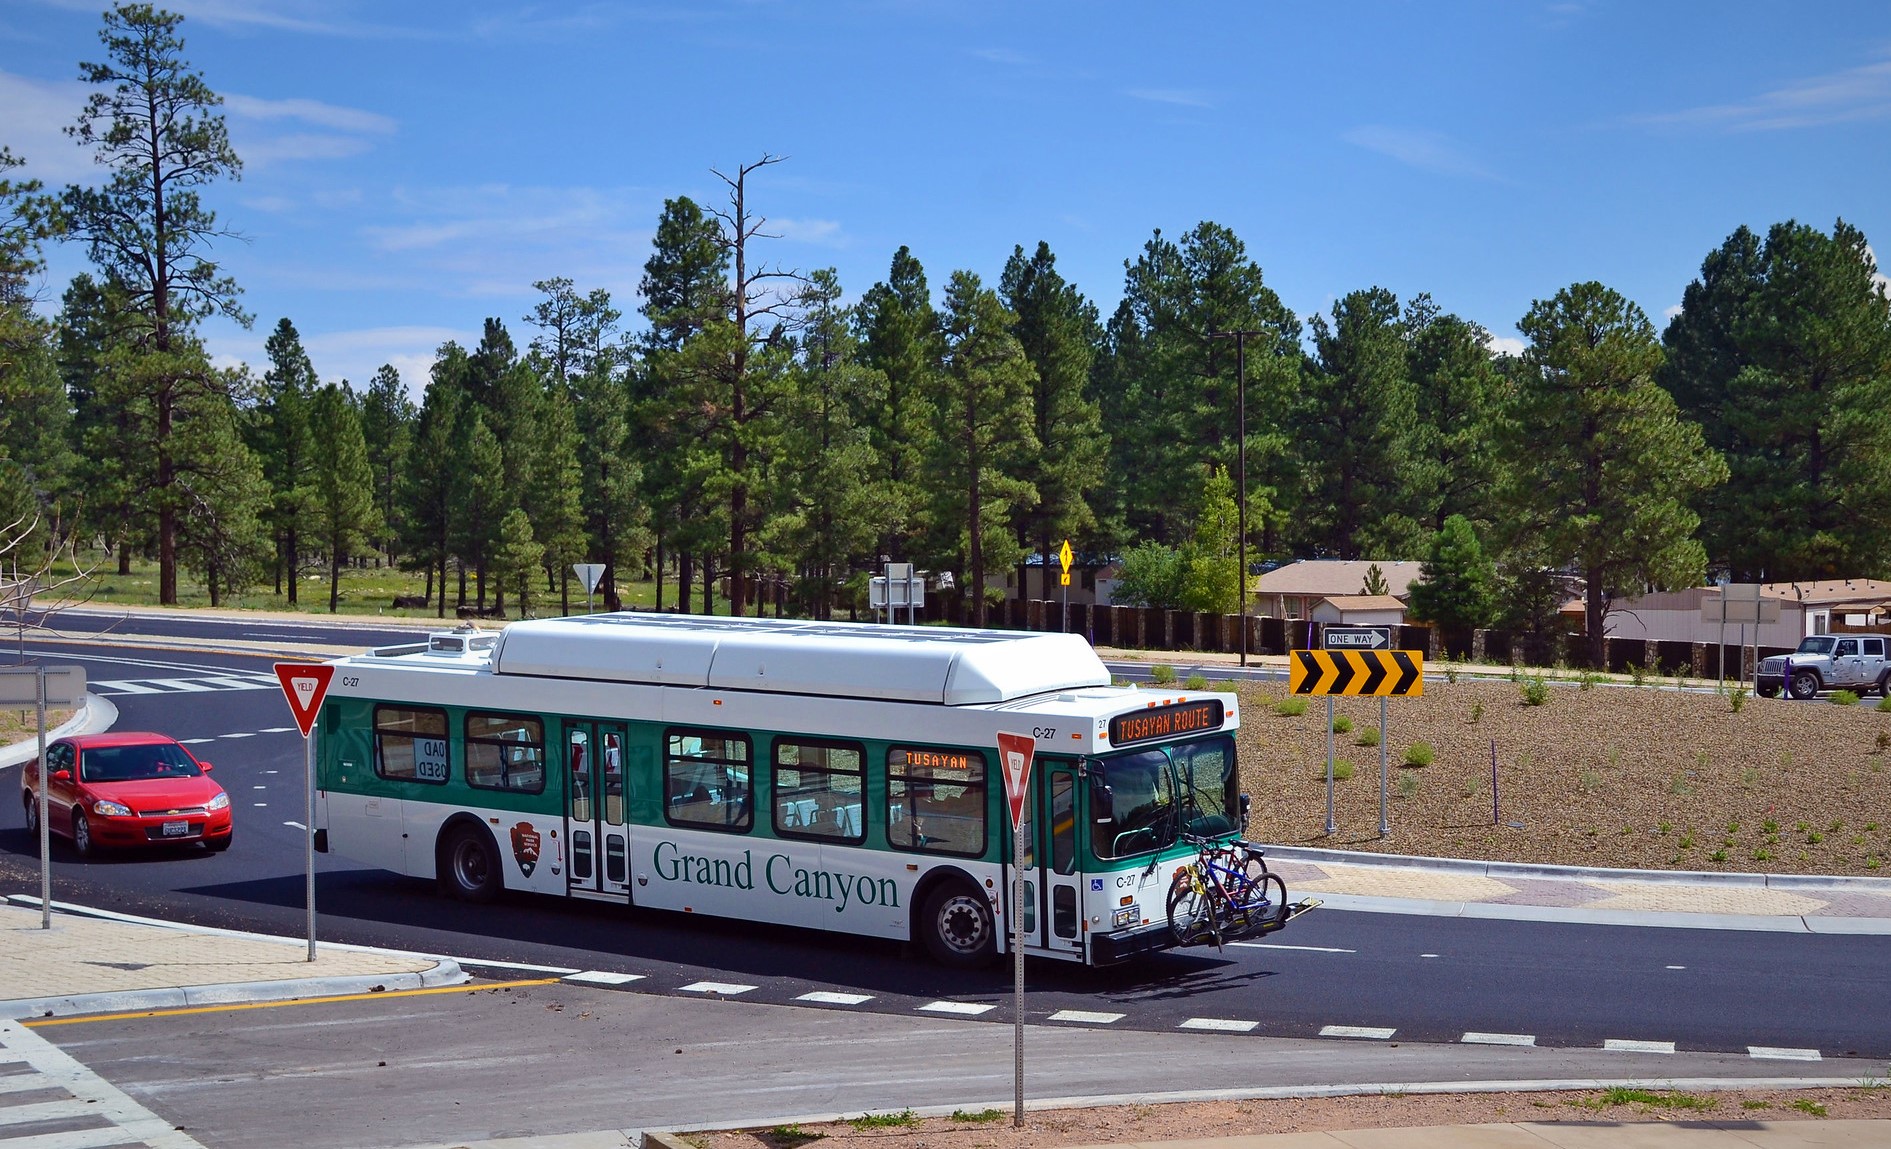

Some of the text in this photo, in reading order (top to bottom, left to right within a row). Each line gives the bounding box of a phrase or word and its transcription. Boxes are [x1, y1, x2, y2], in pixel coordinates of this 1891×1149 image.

[1330, 635, 1373, 643] ONE WAY
[297, 682, 313, 692] YIELD
[342, 676, 360, 687] C-27
[1099, 719, 1107, 729] 27
[1120, 707, 1209, 741] TUSAYAN ROUTE
[1032, 726, 1057, 740] C-27
[905, 751, 968, 769] TUSAYAN
[653, 841, 901, 913] Grand Canyon
[1116, 874, 1136, 889] C-27
